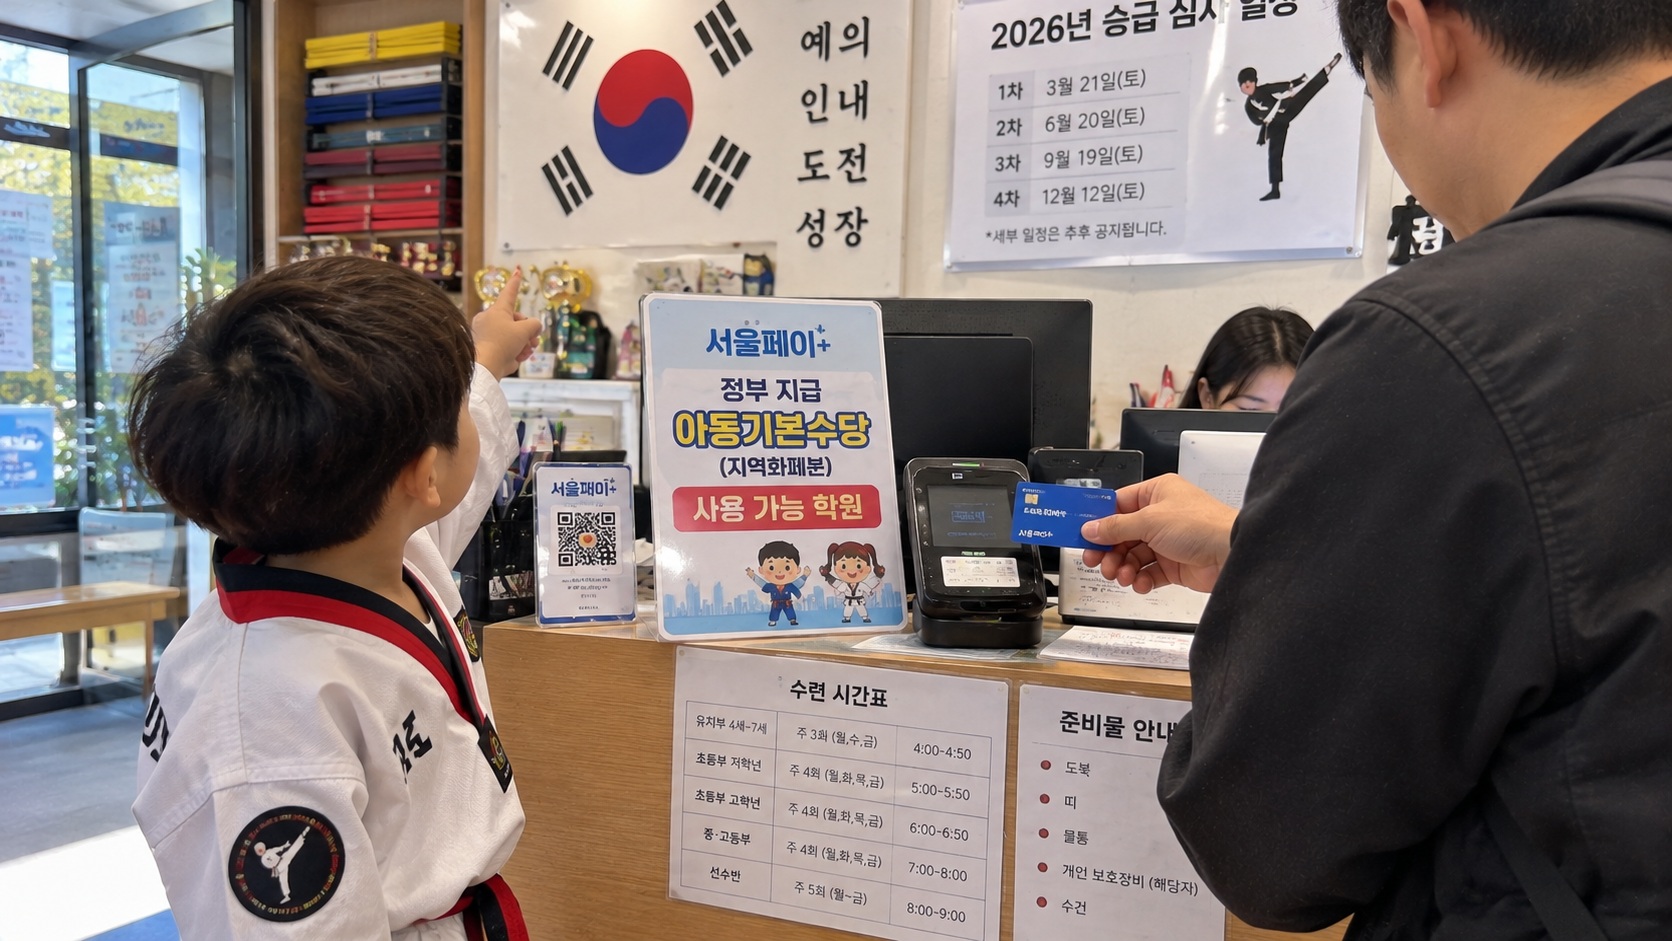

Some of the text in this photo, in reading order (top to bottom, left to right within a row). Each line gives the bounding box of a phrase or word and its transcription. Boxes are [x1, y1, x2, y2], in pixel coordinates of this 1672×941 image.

[801, 16, 869, 61] 예의
[991, 8, 1092, 50] 2026년
[1102, 2, 1160, 37] 승급
[998, 69, 1146, 100] 1차 3월 21일(토)
[801, 80, 868, 124] 인내
[996, 107, 1145, 137] 2차 6월 20일(토)
[797, 143, 868, 183] 도전
[995, 144, 1143, 173] 3차 9월 19일(토)
[993, 182, 1145, 208] 4차 12월 12일(토)
[796, 207, 869, 249] 성장
[1022, 226, 1060, 243] 일정은
[1064, 224, 1091, 240] 추후
[721, 378, 822, 402] 정부 지급
[673, 410, 872, 449] 아동기본수당
[693, 493, 863, 522] 사용 가능 학원
[790, 680, 888, 708] 수련 시간표
[696, 714, 726, 729] 유치부
[797, 727, 807, 740] 주
[913, 743, 972, 760] 4:00-4:50
[1060, 710, 1179, 744] 준비물 안내
[696, 752, 726, 767] 초등부
[789, 764, 800, 777] 주
[911, 782, 971, 800] 5:00-5:50
[695, 789, 726, 804] 초등부
[788, 802, 799, 815] 주
[909, 822, 969, 841] 6:00-6:50
[1064, 796, 1077, 810] 띠
[787, 841, 797, 854] 주
[908, 862, 968, 882] 7:00-8:00
[709, 866, 741, 883] 선수반
[794, 881, 805, 894] 주
[906, 902, 966, 923] 8:00-9:00
[1092, 868, 1144, 889] 보호장비
[1149, 876, 1199, 897] (해당자)
[1062, 899, 1087, 916] 수건
